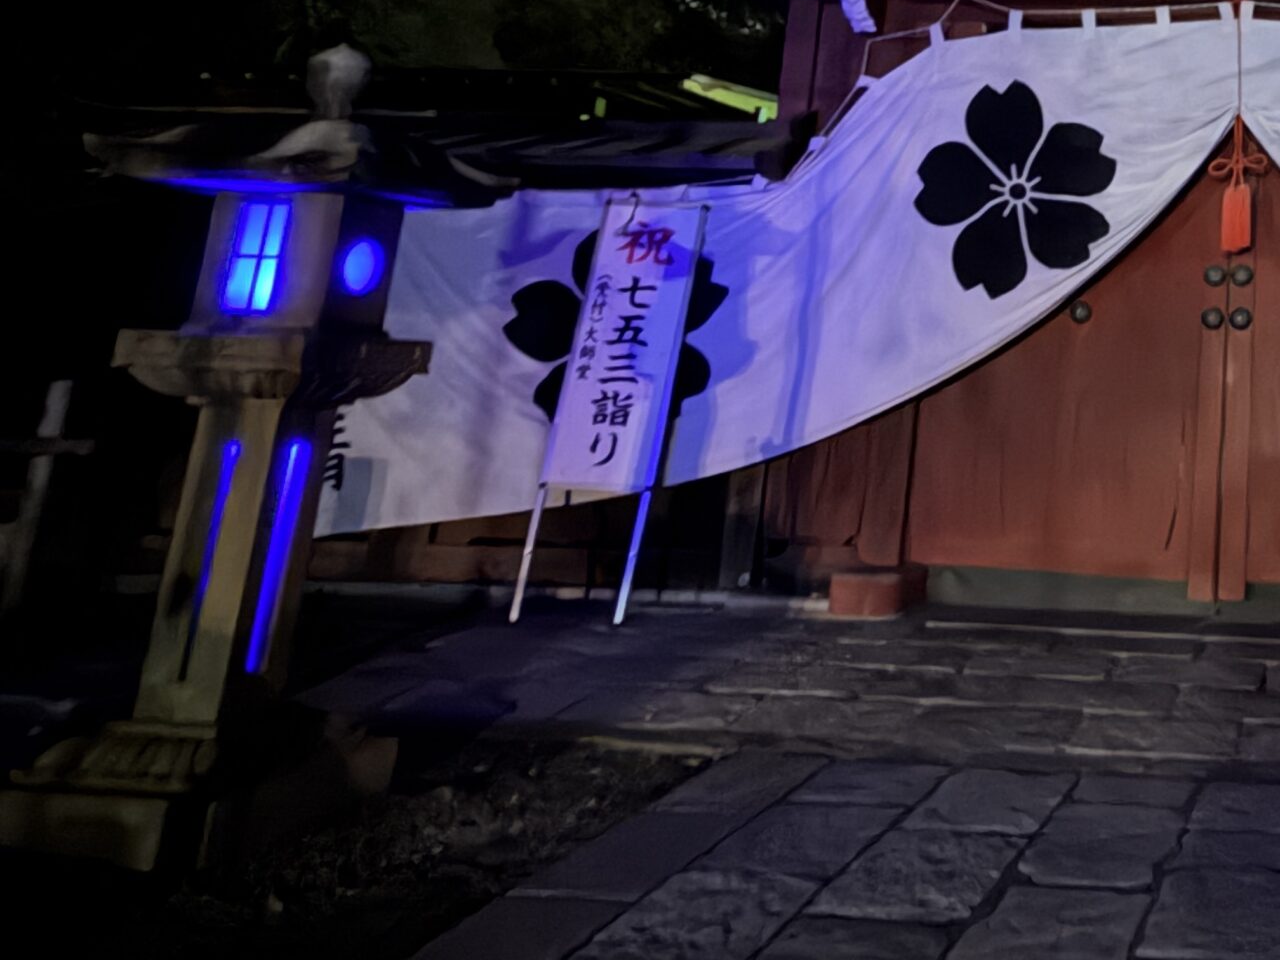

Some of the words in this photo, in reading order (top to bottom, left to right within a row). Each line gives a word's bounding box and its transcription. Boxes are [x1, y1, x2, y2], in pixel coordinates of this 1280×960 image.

[616, 220, 675, 266] 祝
[589, 276, 657, 467] 七五三詣り
